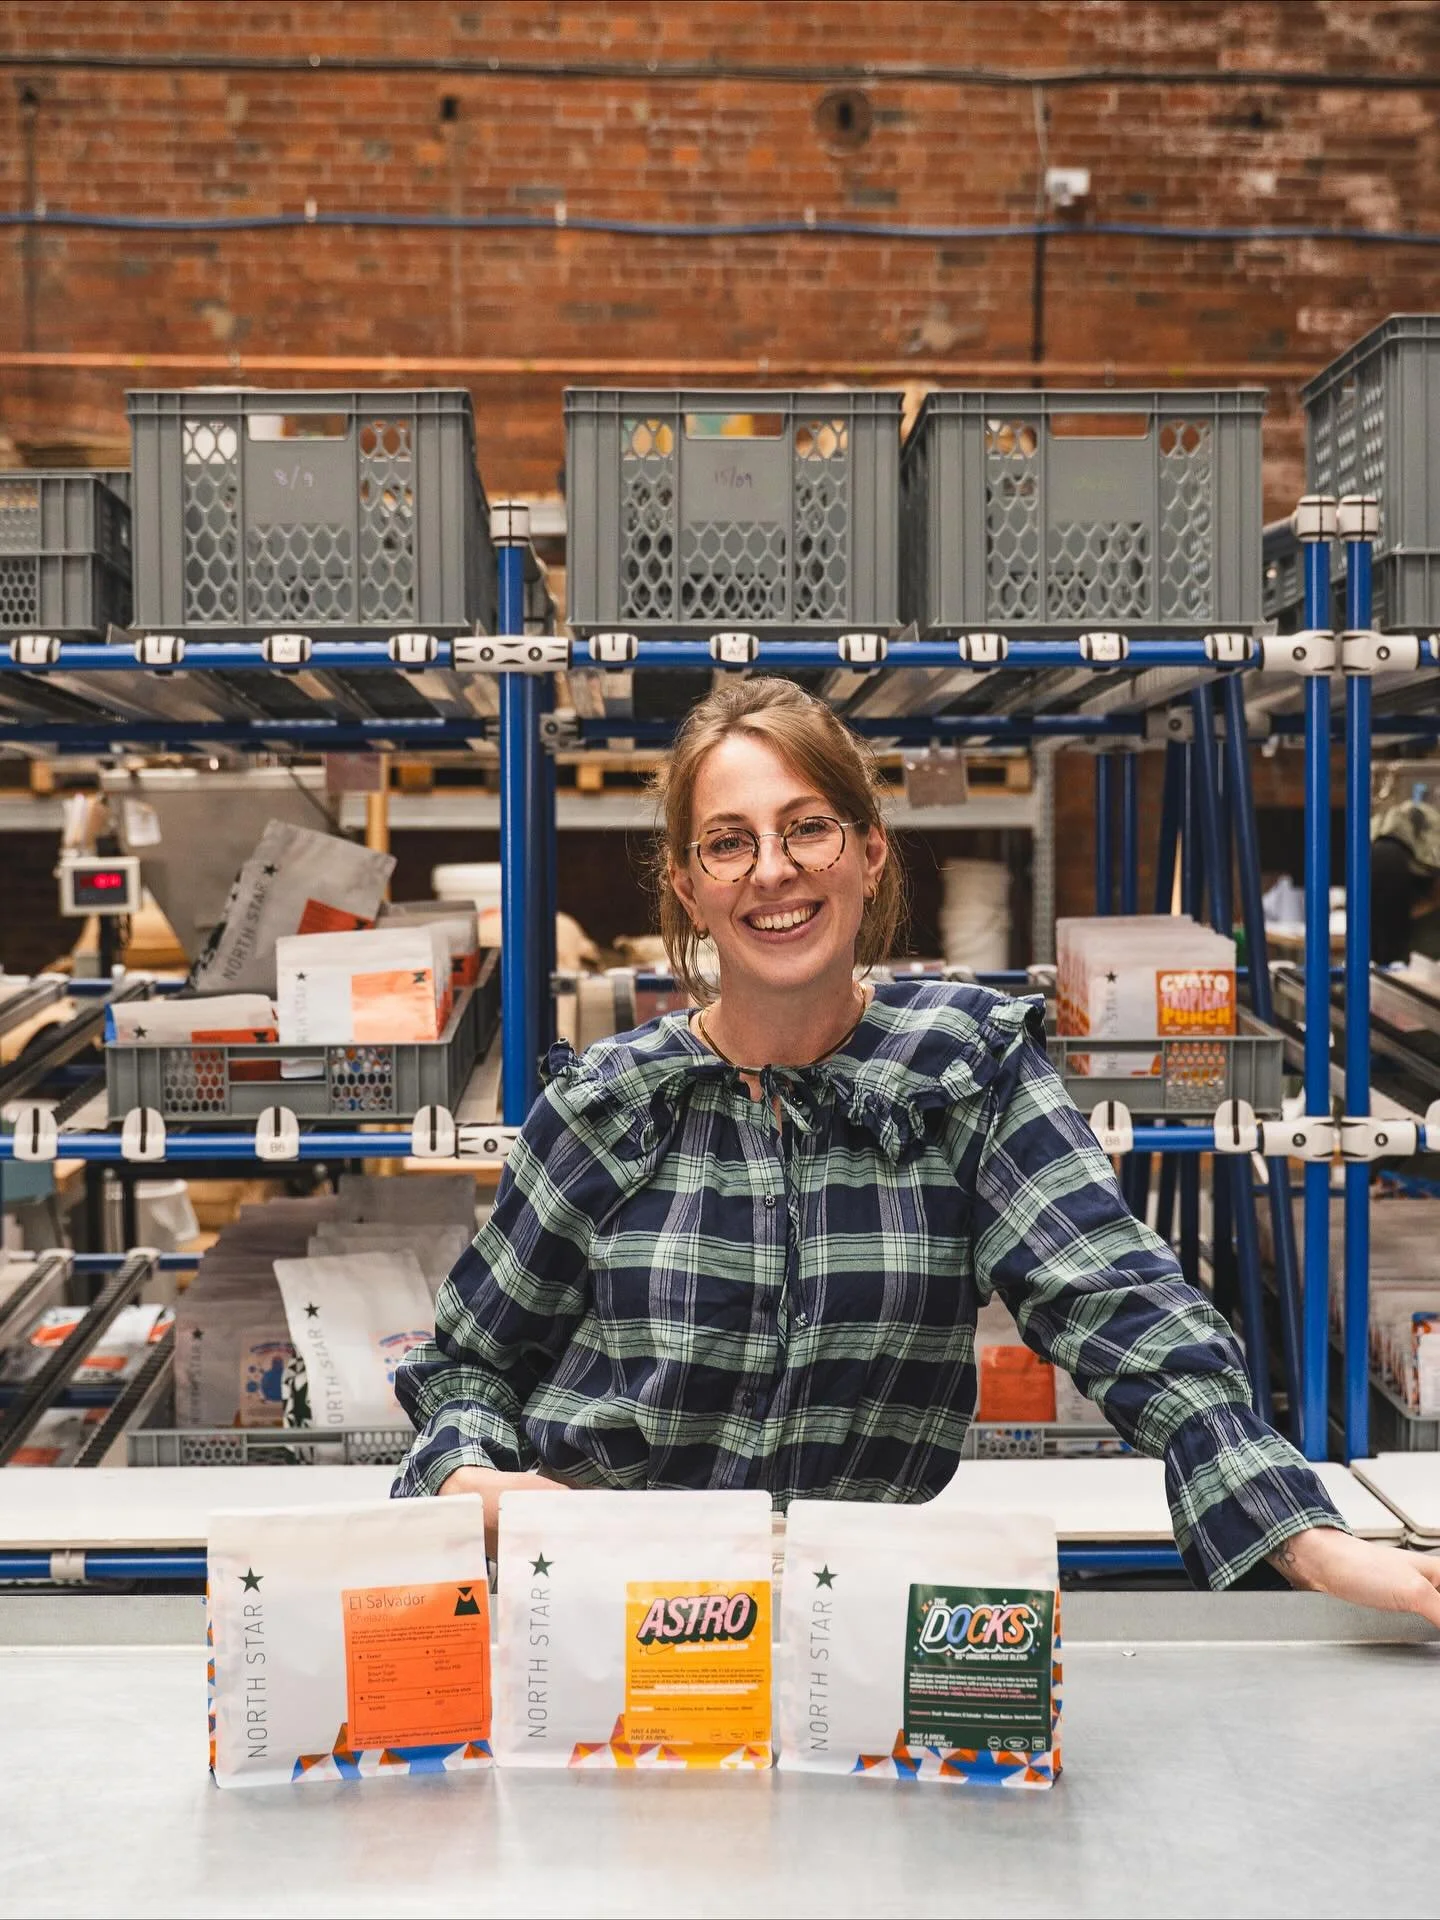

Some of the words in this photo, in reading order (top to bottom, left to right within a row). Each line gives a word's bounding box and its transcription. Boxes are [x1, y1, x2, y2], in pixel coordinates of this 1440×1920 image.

[222, 926, 257, 981] NORTH
[246, 879, 267, 923] STAR
[1159, 987, 1231, 1011] TROPICAL
[1161, 1007, 1231, 1025] PUNCH
[307, 1327, 335, 1371] STAR
[326, 1376, 345, 1425] ORTH
[349, 1595, 363, 1610] El
[366, 1592, 427, 1610] Salvador
[528, 1587, 552, 1647] STAR
[636, 1593, 755, 1642] ASTRO
[243, 1604, 266, 1665] STAR
[810, 1600, 833, 1661] STAR
[921, 1605, 1034, 1648] DOCKS
[991, 1653, 1009, 1661] HOUSE
[1010, 1653, 1028, 1662] BLEND
[246, 1677, 268, 1759] NORTH
[527, 1658, 549, 1739] NORTH
[808, 1671, 830, 1751] NORTH
[909, 1732, 924, 1740] HAVE
[909, 1739, 924, 1747] HAVE
